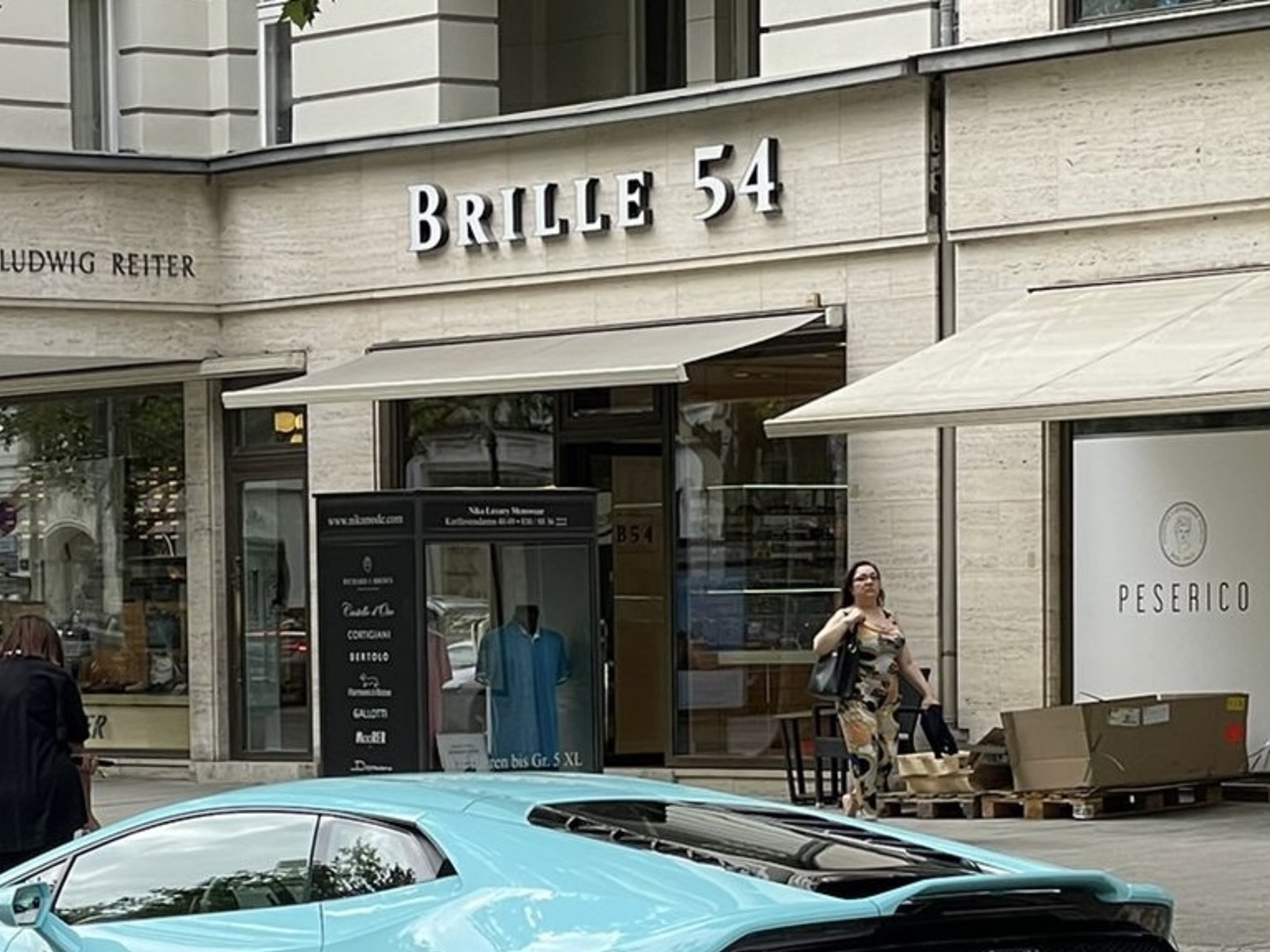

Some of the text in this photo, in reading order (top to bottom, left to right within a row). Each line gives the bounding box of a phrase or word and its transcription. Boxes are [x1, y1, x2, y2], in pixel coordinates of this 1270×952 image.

[692, 136, 785, 223] 54
[0, 248, 196, 278] LUDWIG REITER
[1118, 581, 1250, 614] PESERICO
[349, 651, 390, 662] BERTOLO
[511, 753, 529, 769] bis
[531, 752, 551, 768] Gr.
[553, 752, 561, 767] 5
[563, 751, 583, 767] XL
